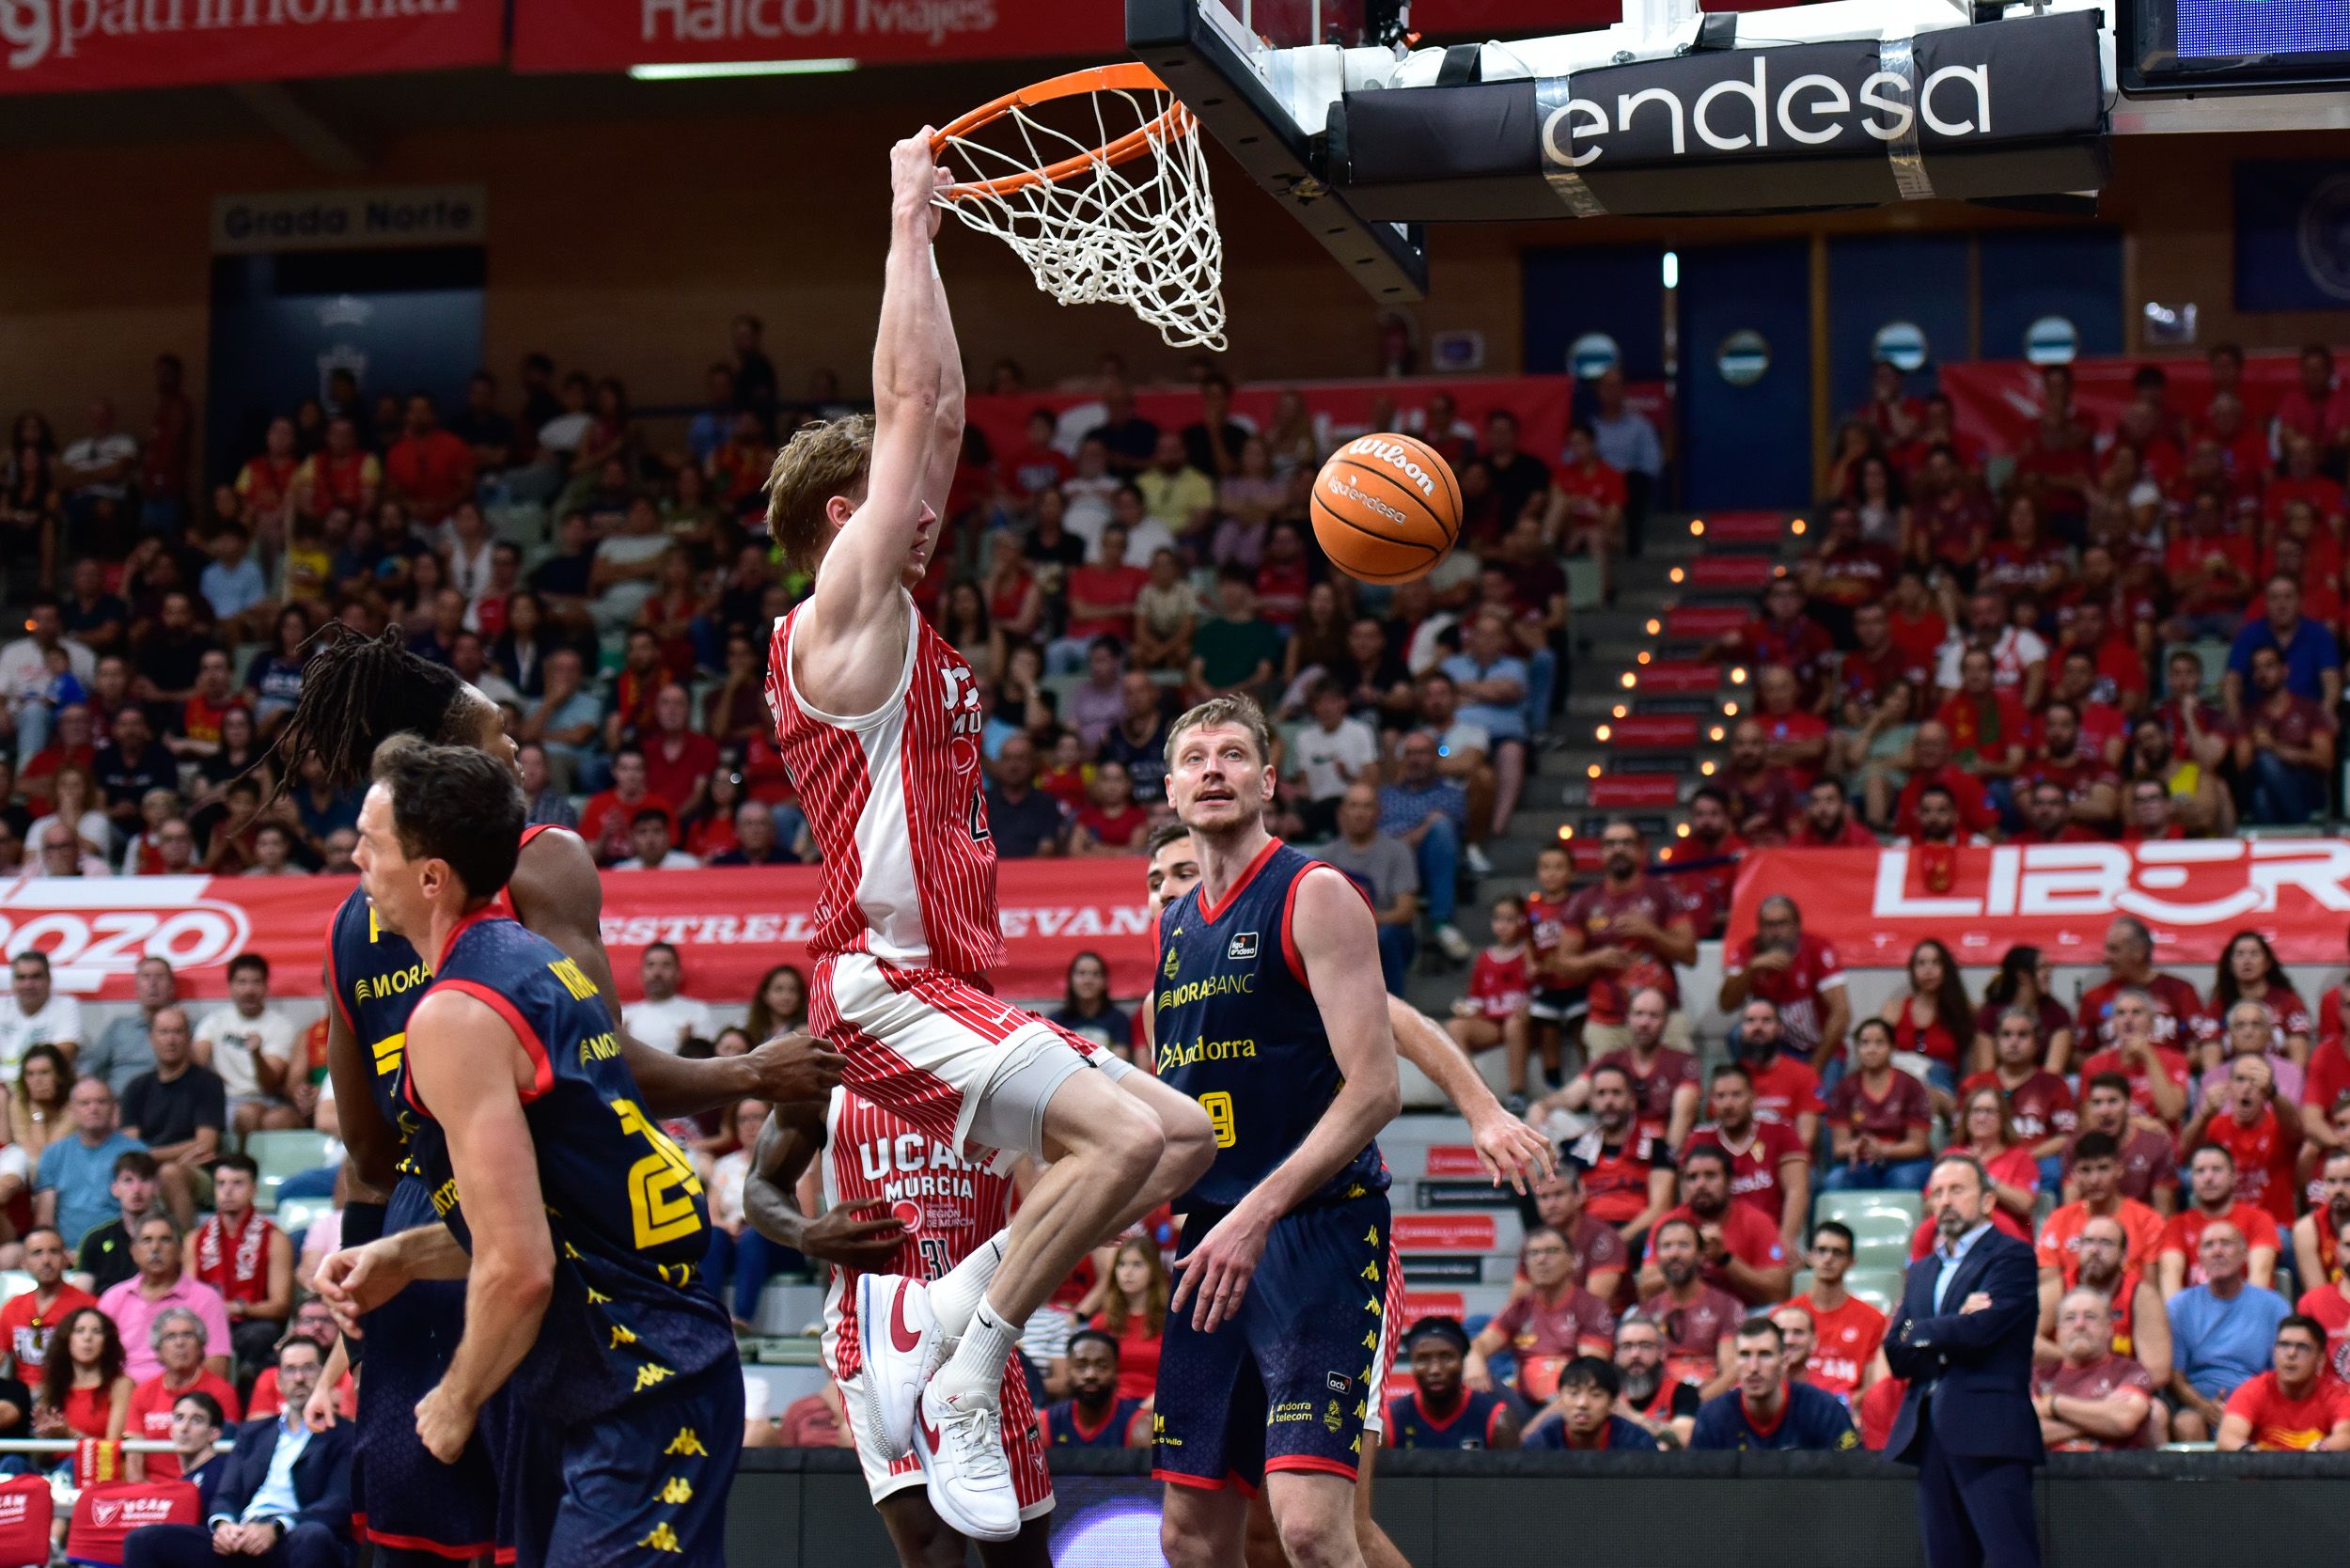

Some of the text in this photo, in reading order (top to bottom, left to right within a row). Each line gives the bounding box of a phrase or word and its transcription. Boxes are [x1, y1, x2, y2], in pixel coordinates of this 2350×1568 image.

[1542, 56, 1991, 167] endesa
[1349, 438, 1434, 497] Wilson
[1173, 973, 1255, 1009] MORABANC
[1170, 1035, 1257, 1068] Andorra
[884, 1175, 974, 1203] MURCIA
[1329, 1379, 1346, 1391] acb
[1276, 1412, 1313, 1422] telecom
[1277, 1402, 1312, 1412] andorra
